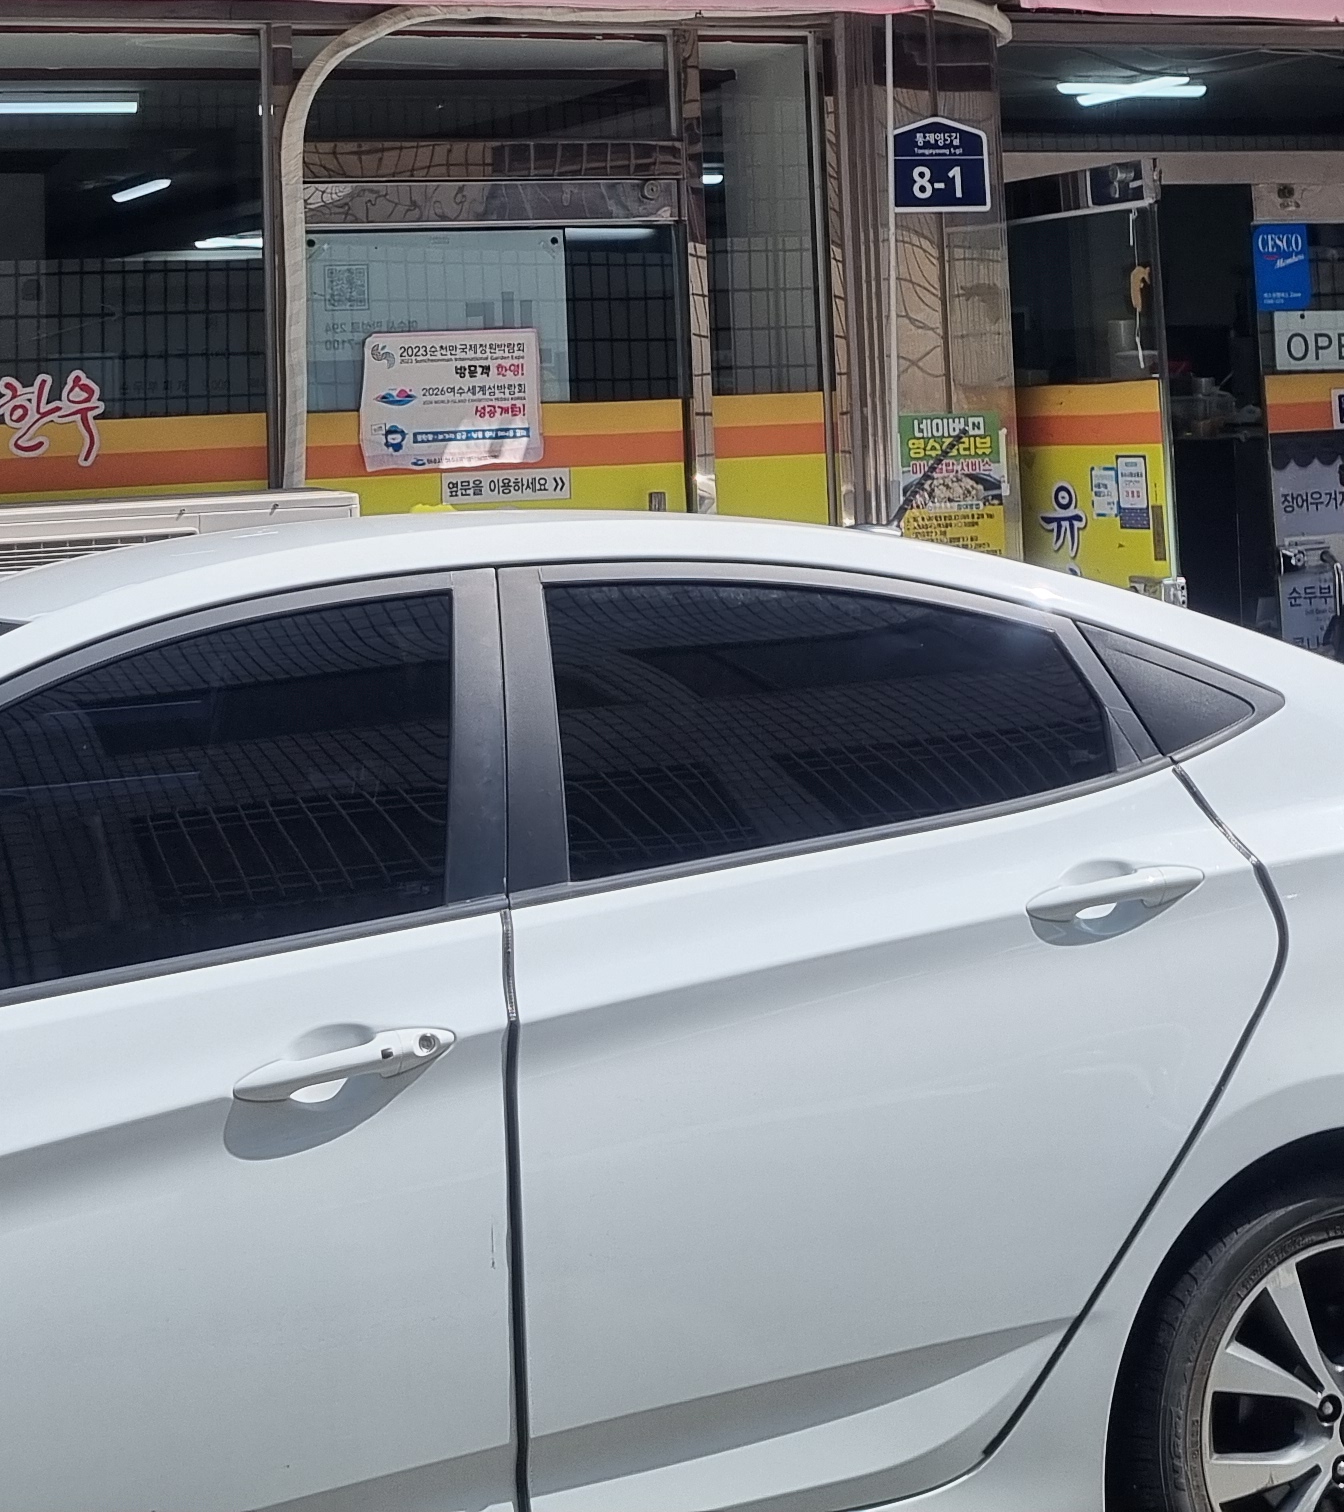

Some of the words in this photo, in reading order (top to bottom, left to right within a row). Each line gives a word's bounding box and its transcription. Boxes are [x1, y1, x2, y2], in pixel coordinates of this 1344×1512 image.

[912, 166, 963, 199] 8-1
[1258, 233, 1302, 253] CESCO
[913, 417, 965, 438] 네이버
[959, 458, 993, 473] 서비스
[447, 479, 484, 498] 옆문을
[489, 476, 548, 495] 이용하세요
